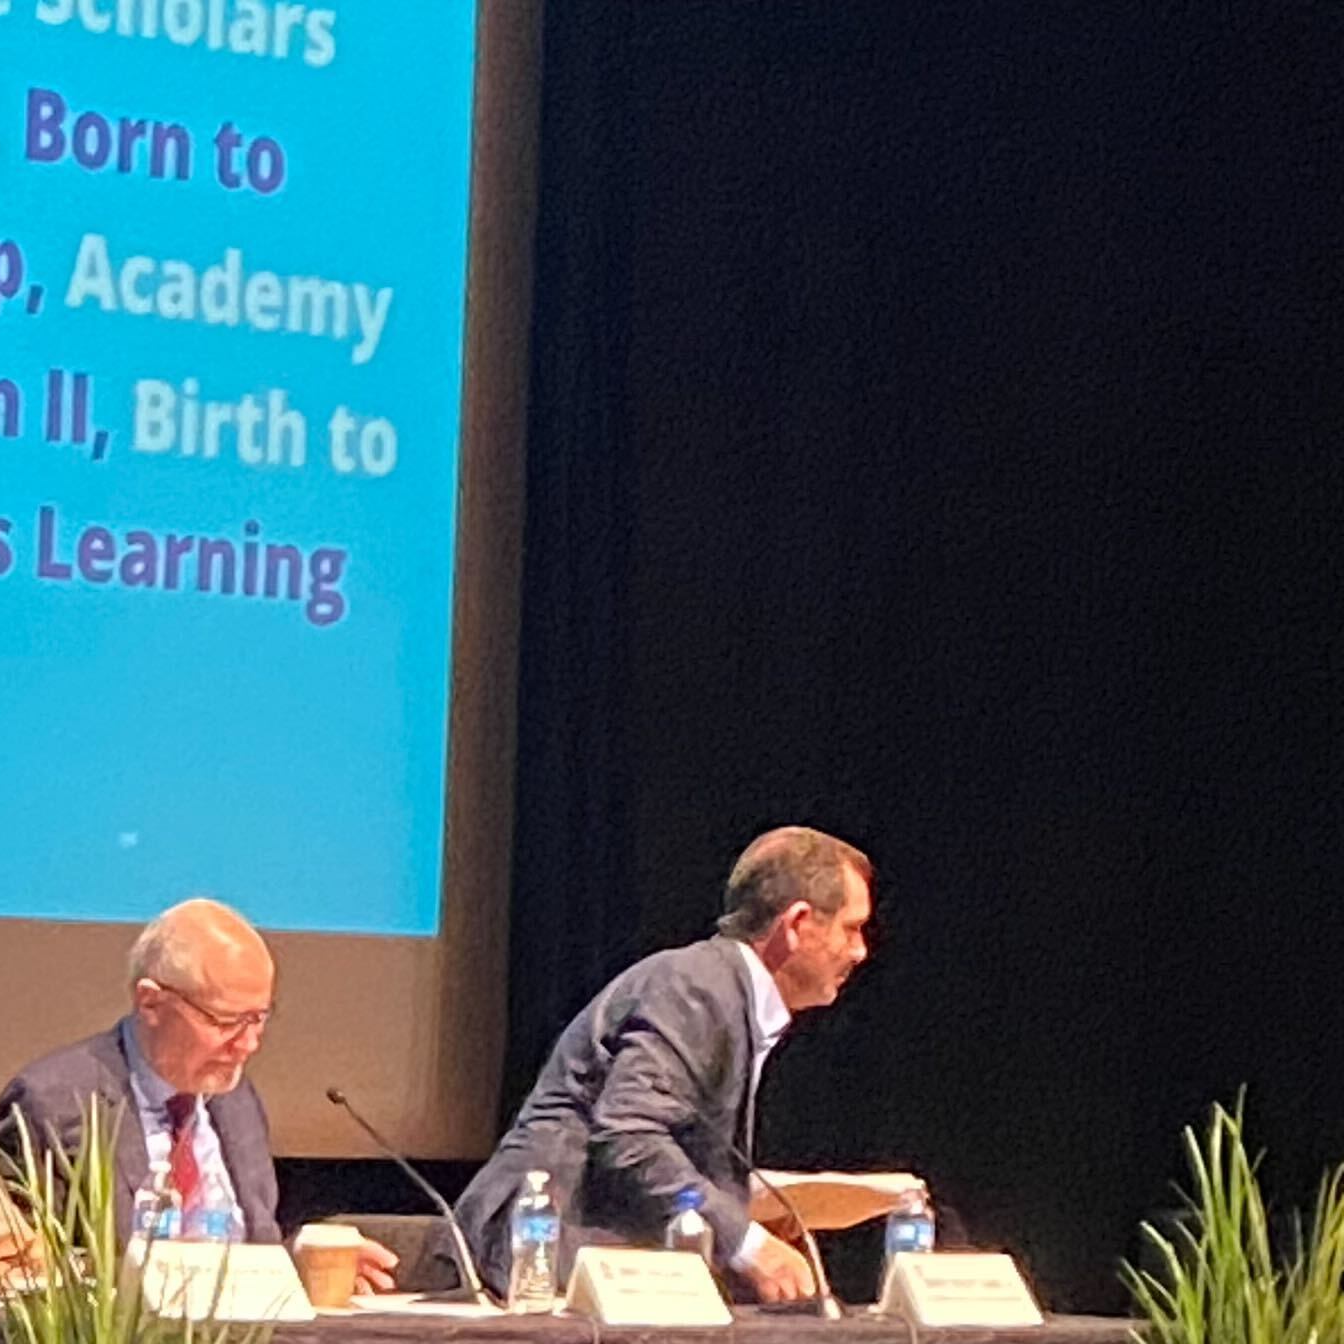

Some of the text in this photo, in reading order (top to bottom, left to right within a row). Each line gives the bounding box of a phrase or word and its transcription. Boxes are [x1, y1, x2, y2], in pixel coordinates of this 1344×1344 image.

[24, 86, 191, 182] Born
[212, 120, 285, 195] to
[64, 233, 394, 365] Academy
[45, 368, 110, 461] II,
[132, 378, 308, 468] Birth
[327, 406, 399, 477] to
[36, 505, 347, 627] Learning
